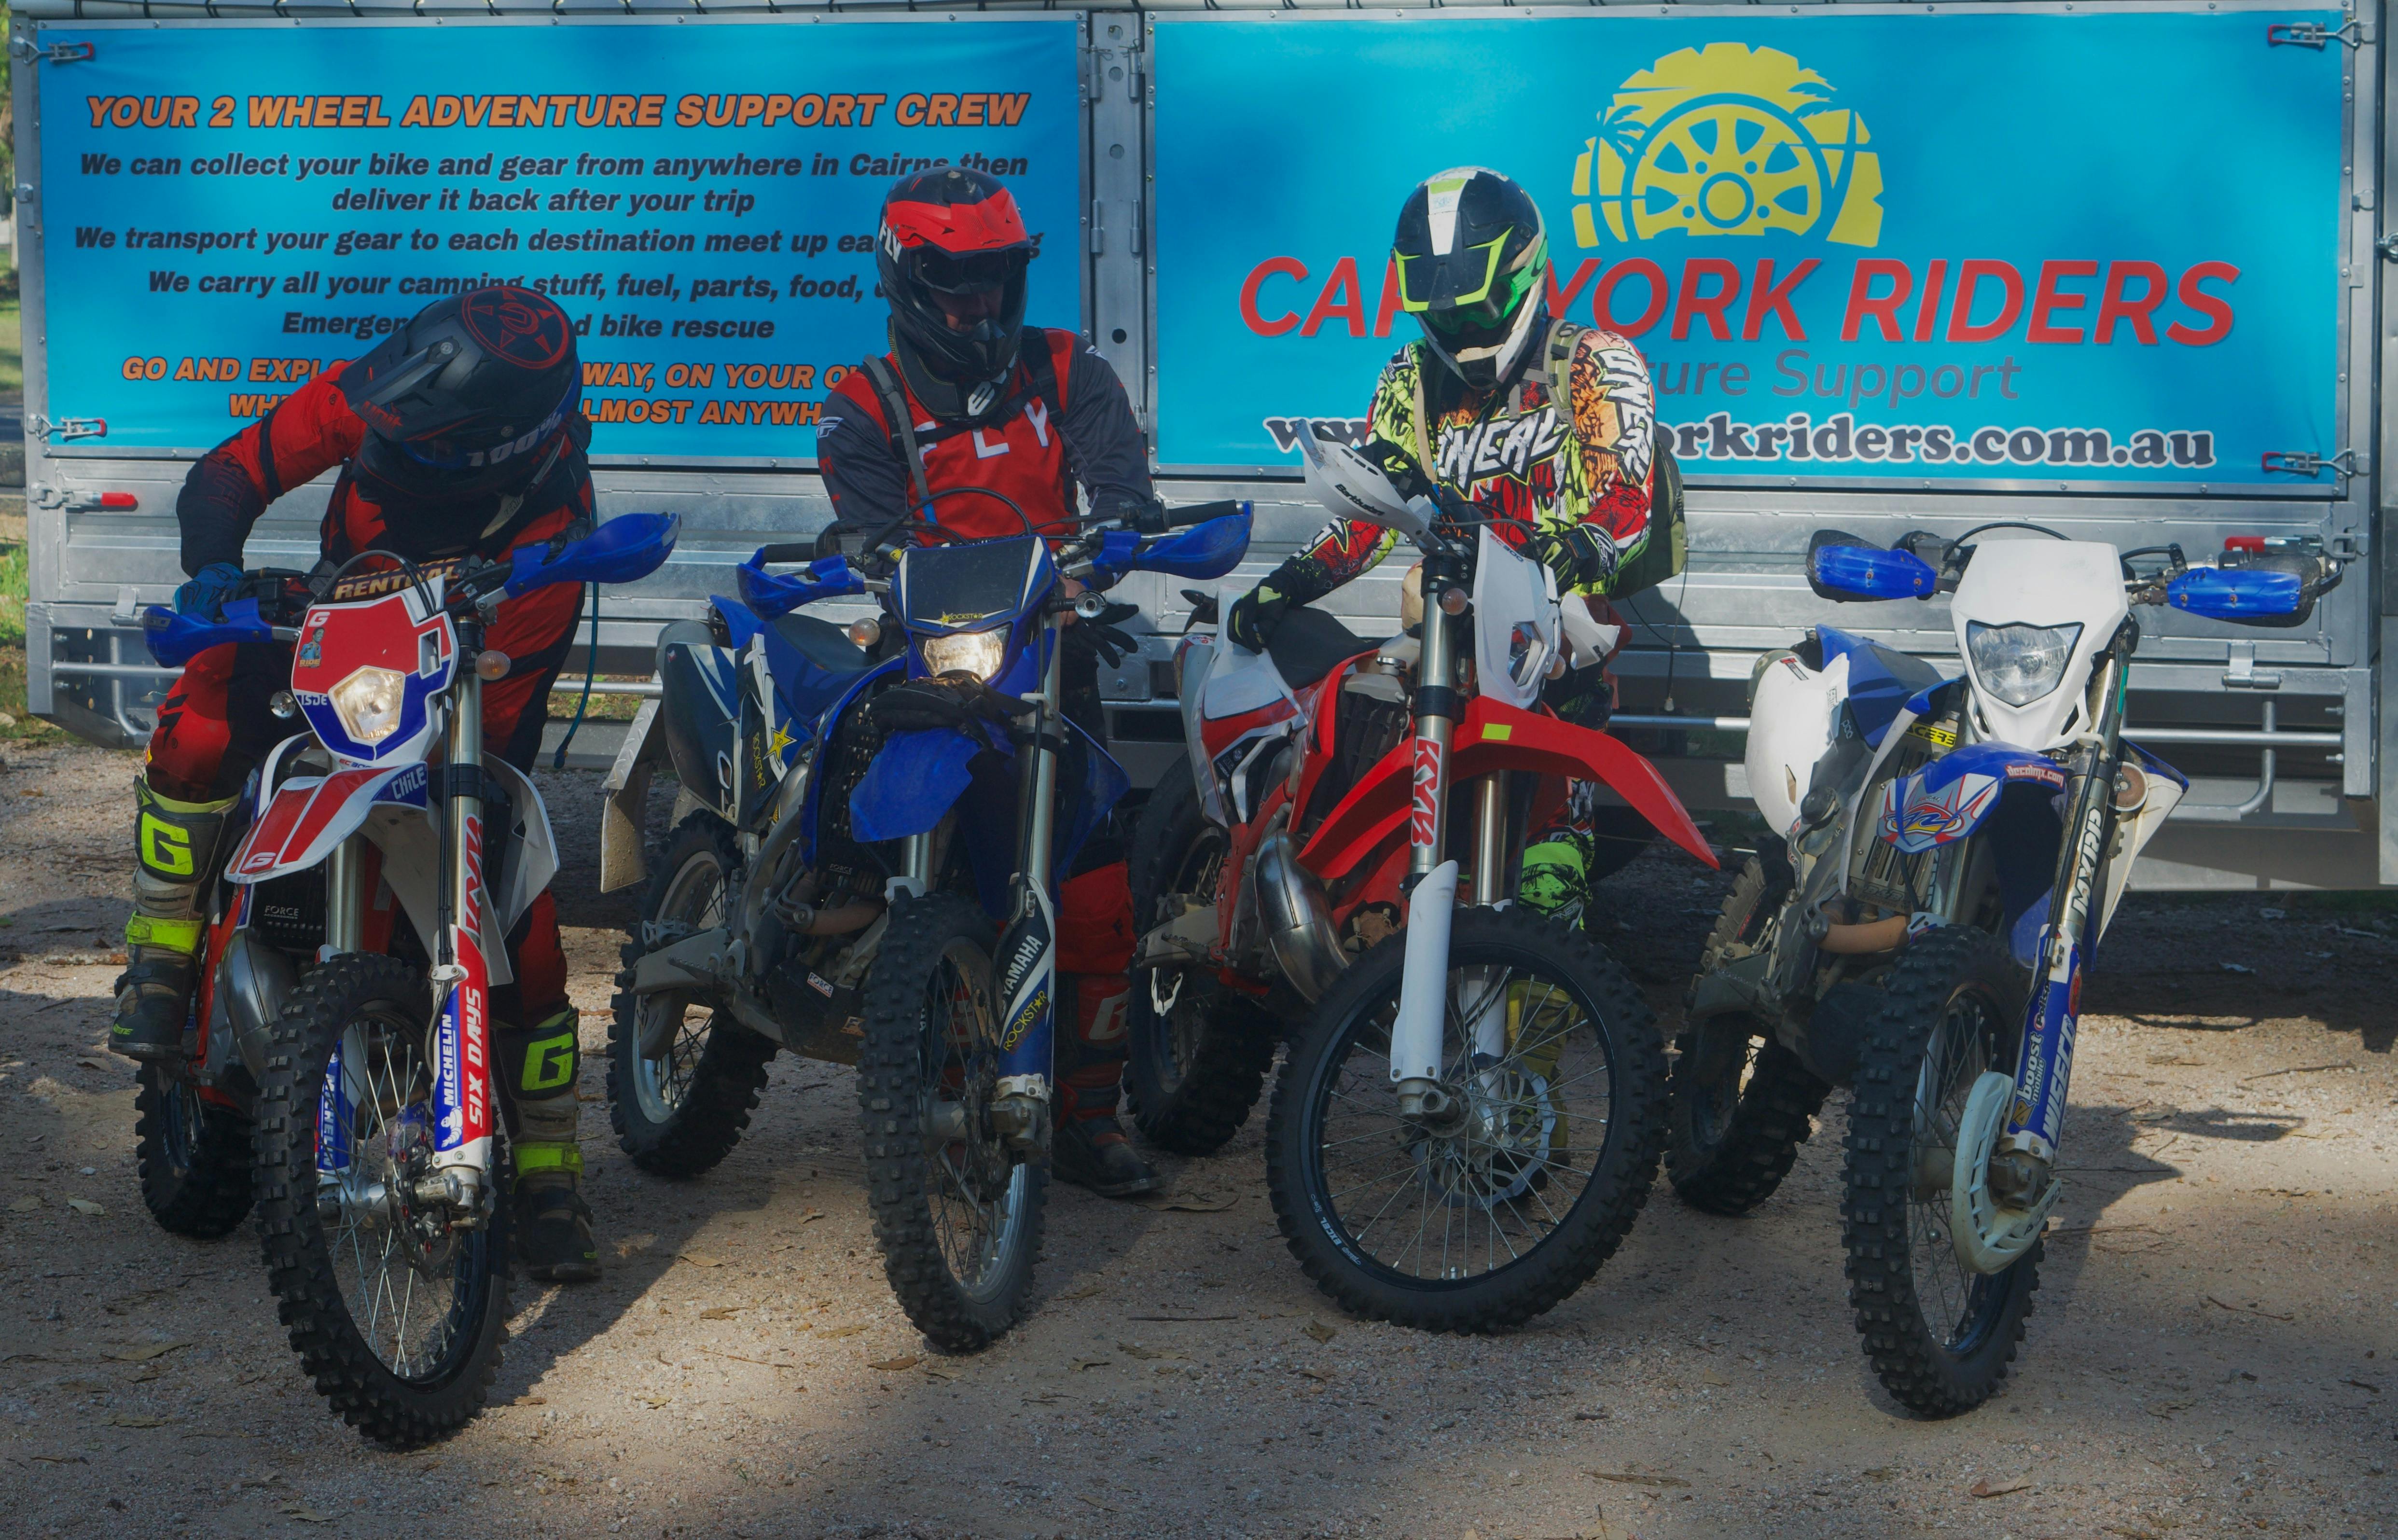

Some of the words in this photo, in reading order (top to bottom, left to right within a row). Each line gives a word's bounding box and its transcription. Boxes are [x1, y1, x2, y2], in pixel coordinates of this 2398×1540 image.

[86, 95, 200, 129] YOUR
[208, 95, 236, 128] 2
[248, 95, 391, 128] WHEEL
[400, 95, 667, 128] ADVENTURE
[675, 93, 887, 128] SUPPORT
[895, 93, 1032, 127] CREW
[81, 153, 122, 176] We
[131, 157, 182, 176] can
[191, 152, 290, 176] collect
[296, 158, 362, 182] your
[368, 152, 430, 176] bike
[438, 153, 493, 176] and
[498, 158, 569, 182] gear
[576, 153, 645, 176] from
[653, 153, 803, 182] anywhere
[811, 153, 840, 176] in
[959, 153, 1029, 176] then
[332, 187, 430, 211] deliver
[439, 188, 461, 211] it
[468, 188, 541, 211] back
[548, 188, 621, 211] after
[627, 193, 696, 216] your
[704, 188, 756, 216] trip
[75, 226, 116, 249] We
[125, 227, 258, 255] transport
[264, 229, 329, 257] your
[335, 233, 402, 256] gear
[411, 228, 440, 251] to
[448, 228, 519, 251] each
[528, 228, 695, 252] destination
[705, 230, 783, 253] meet
[790, 235, 829, 258] up
[878, 220, 902, 264] FLY
[150, 270, 190, 293] We
[198, 276, 277, 299] carry
[283, 270, 320, 294] all
[325, 276, 392, 300] your
[617, 273, 681, 300] fuel,
[690, 275, 778, 300] parts,
[789, 274, 864, 300] food,
[1547, 258, 1822, 341] YORK
[1840, 259, 2242, 346] RIDERS
[600, 313, 663, 338] bike
[671, 319, 776, 339] rescue
[122, 356, 168, 381] GO
[173, 357, 241, 382] AND
[248, 357, 351, 382] EXPL
[665, 362, 716, 388] ON
[724, 363, 816, 389] YOUR
[1771, 348, 2023, 409] Support
[582, 399, 693, 424] LMOST
[698, 400, 823, 425] ANYWH
[466, 412, 563, 467] 100%
[1334, 483, 1385, 516] Barkbusters
[264, 904, 300, 916] FORCE
[1003, 934, 1043, 997] YAMAHA
[442, 1013, 453, 1107] MICHELIN
[2016, 1033, 2044, 1101] boost
[2031, 1058, 2046, 1104] mobile
[468, 1072, 483, 1128] SIX
[1319, 1216, 1343, 1247] EXCEL
